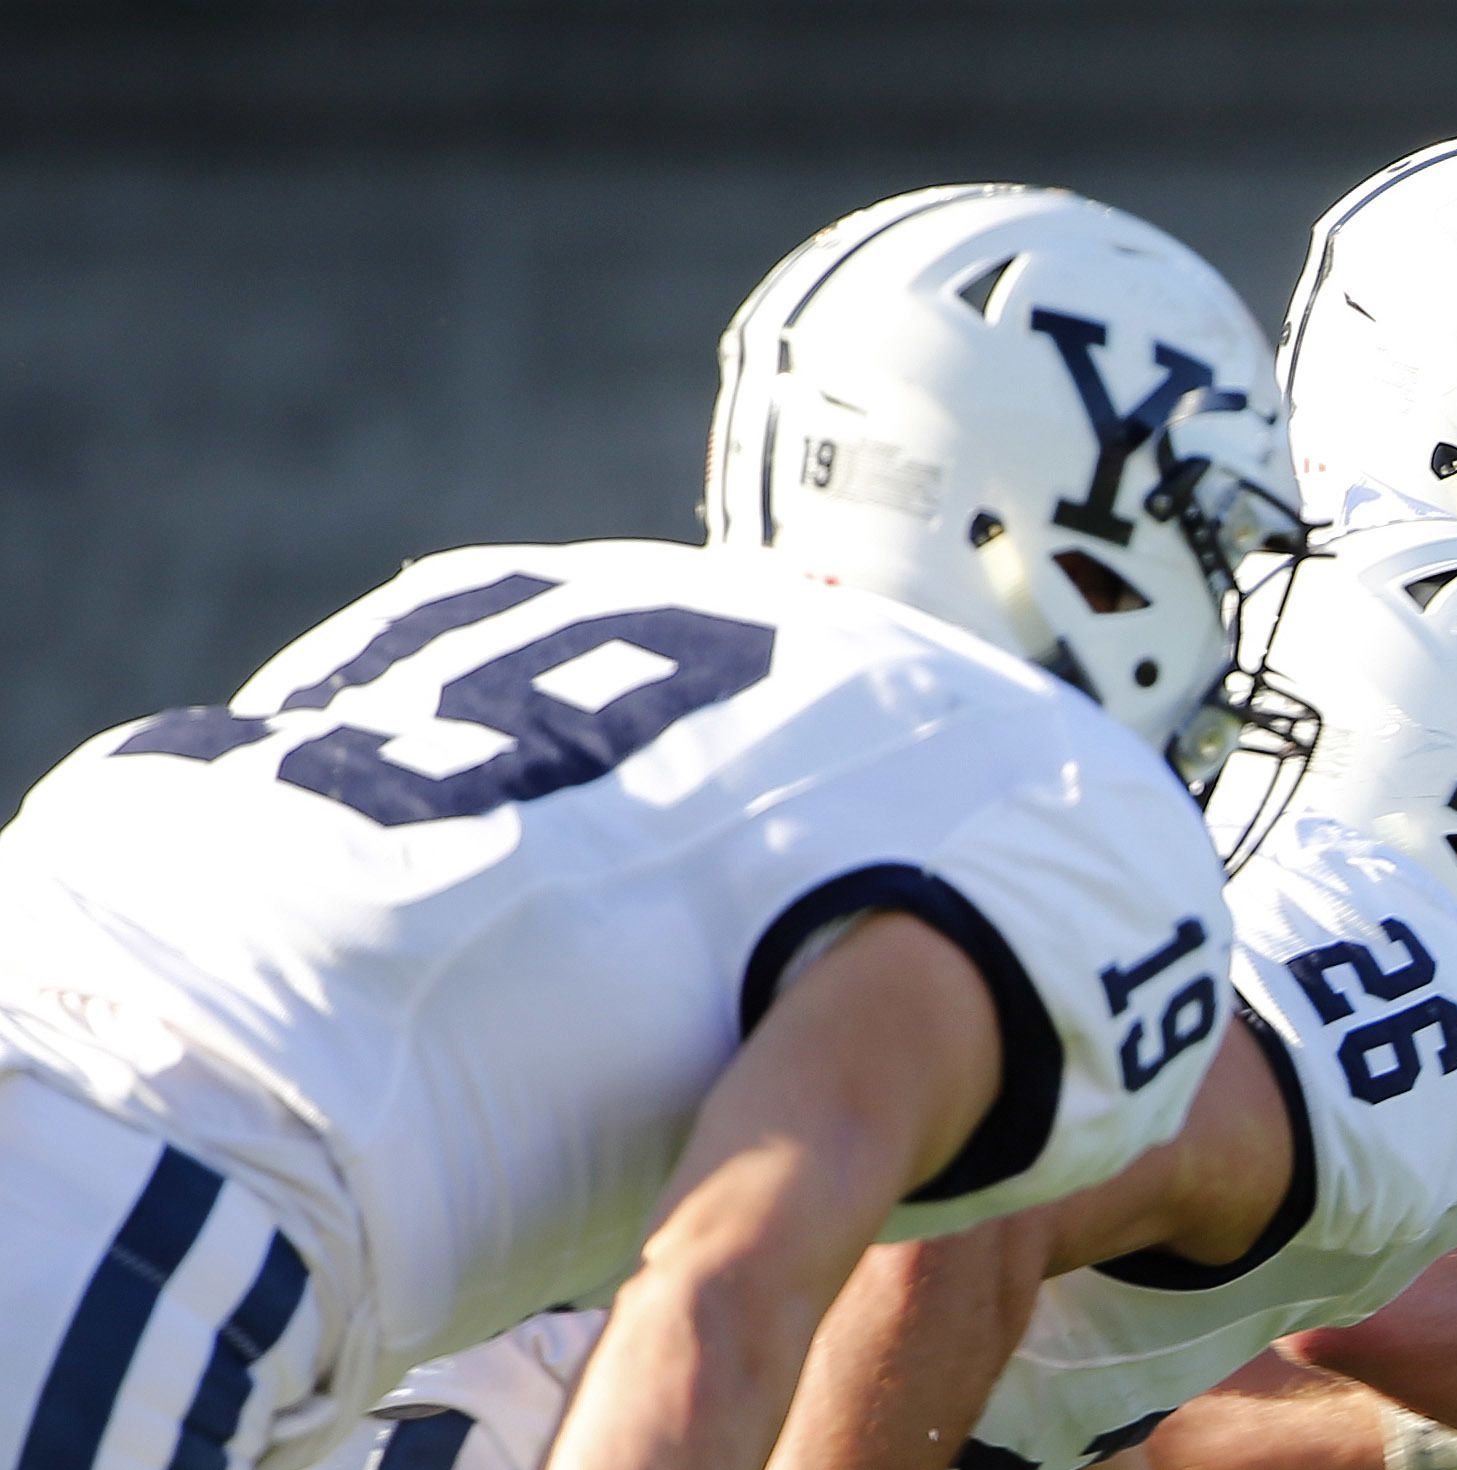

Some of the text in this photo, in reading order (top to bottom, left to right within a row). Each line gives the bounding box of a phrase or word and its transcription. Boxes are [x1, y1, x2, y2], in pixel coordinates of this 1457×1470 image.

[801, 436, 836, 488] 19
[1031, 305, 1216, 547] Y
[105, 572, 776, 828] 19
[1100, 917, 1217, 1093] 19
